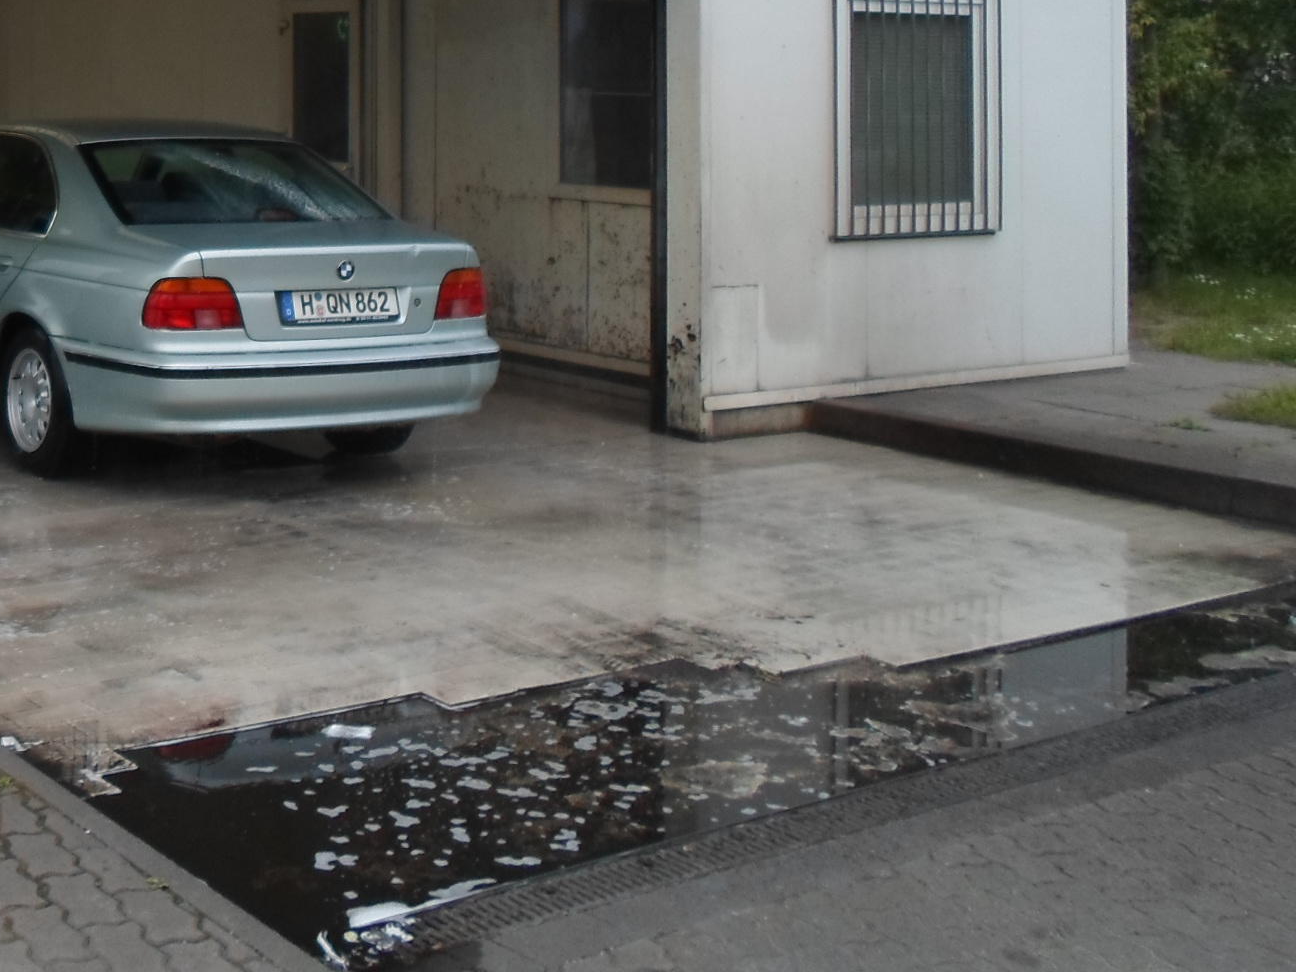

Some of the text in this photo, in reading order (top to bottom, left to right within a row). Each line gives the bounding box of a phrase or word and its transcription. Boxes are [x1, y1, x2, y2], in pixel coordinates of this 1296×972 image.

[300, 291, 390, 315] H QN 862
